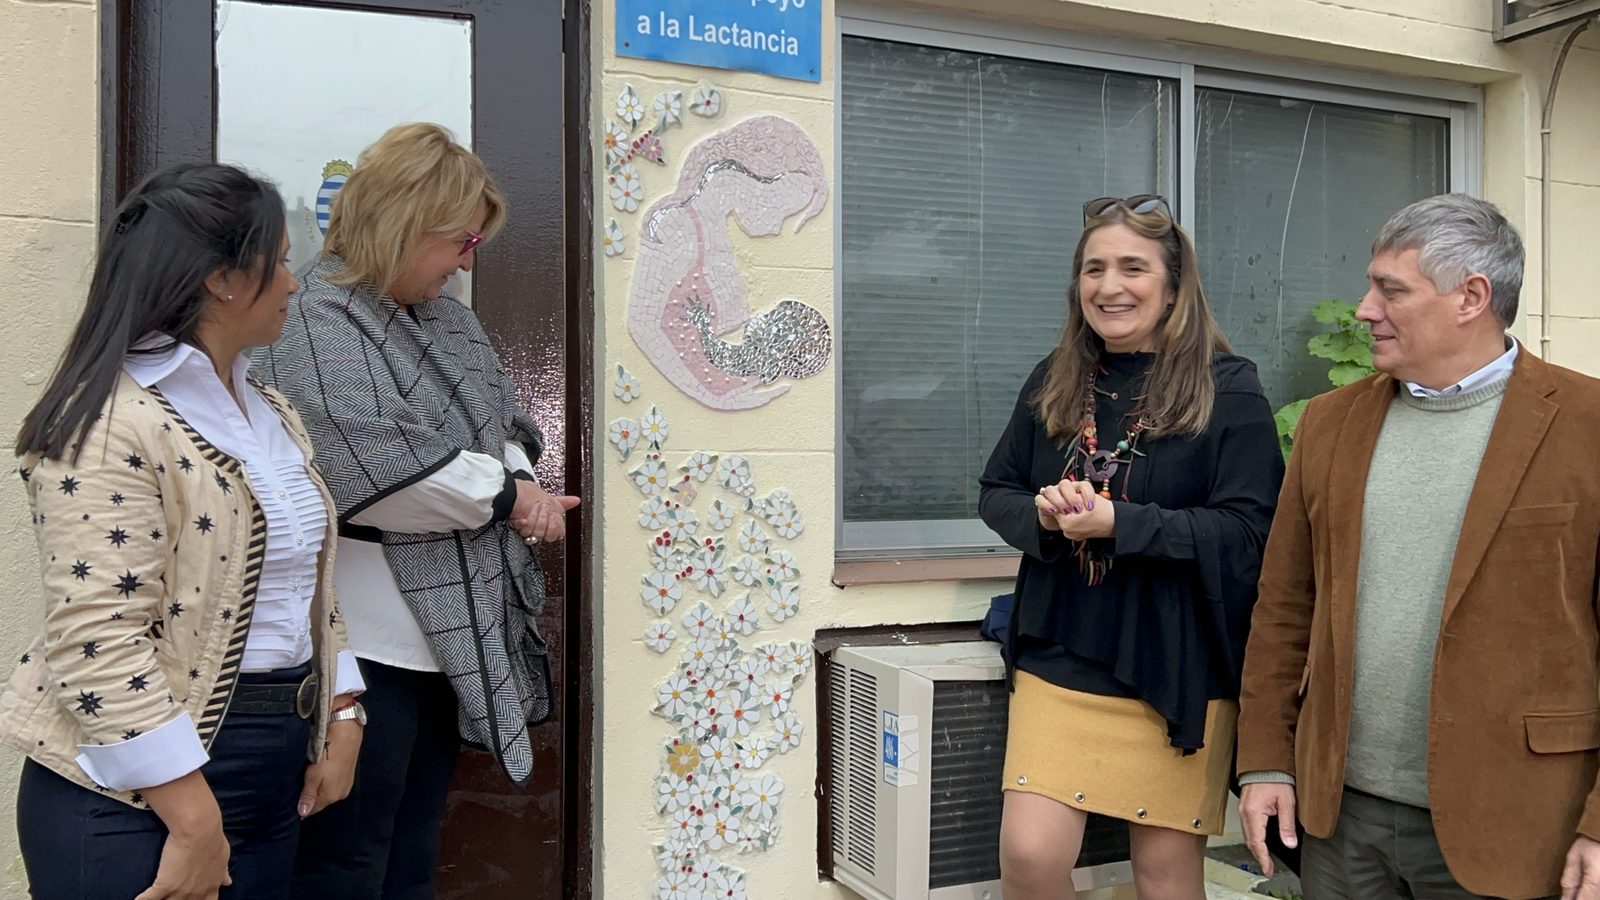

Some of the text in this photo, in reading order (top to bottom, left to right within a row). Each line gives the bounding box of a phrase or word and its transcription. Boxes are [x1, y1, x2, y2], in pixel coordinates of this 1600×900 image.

[637, 11, 799, 56] a la Lactancia
